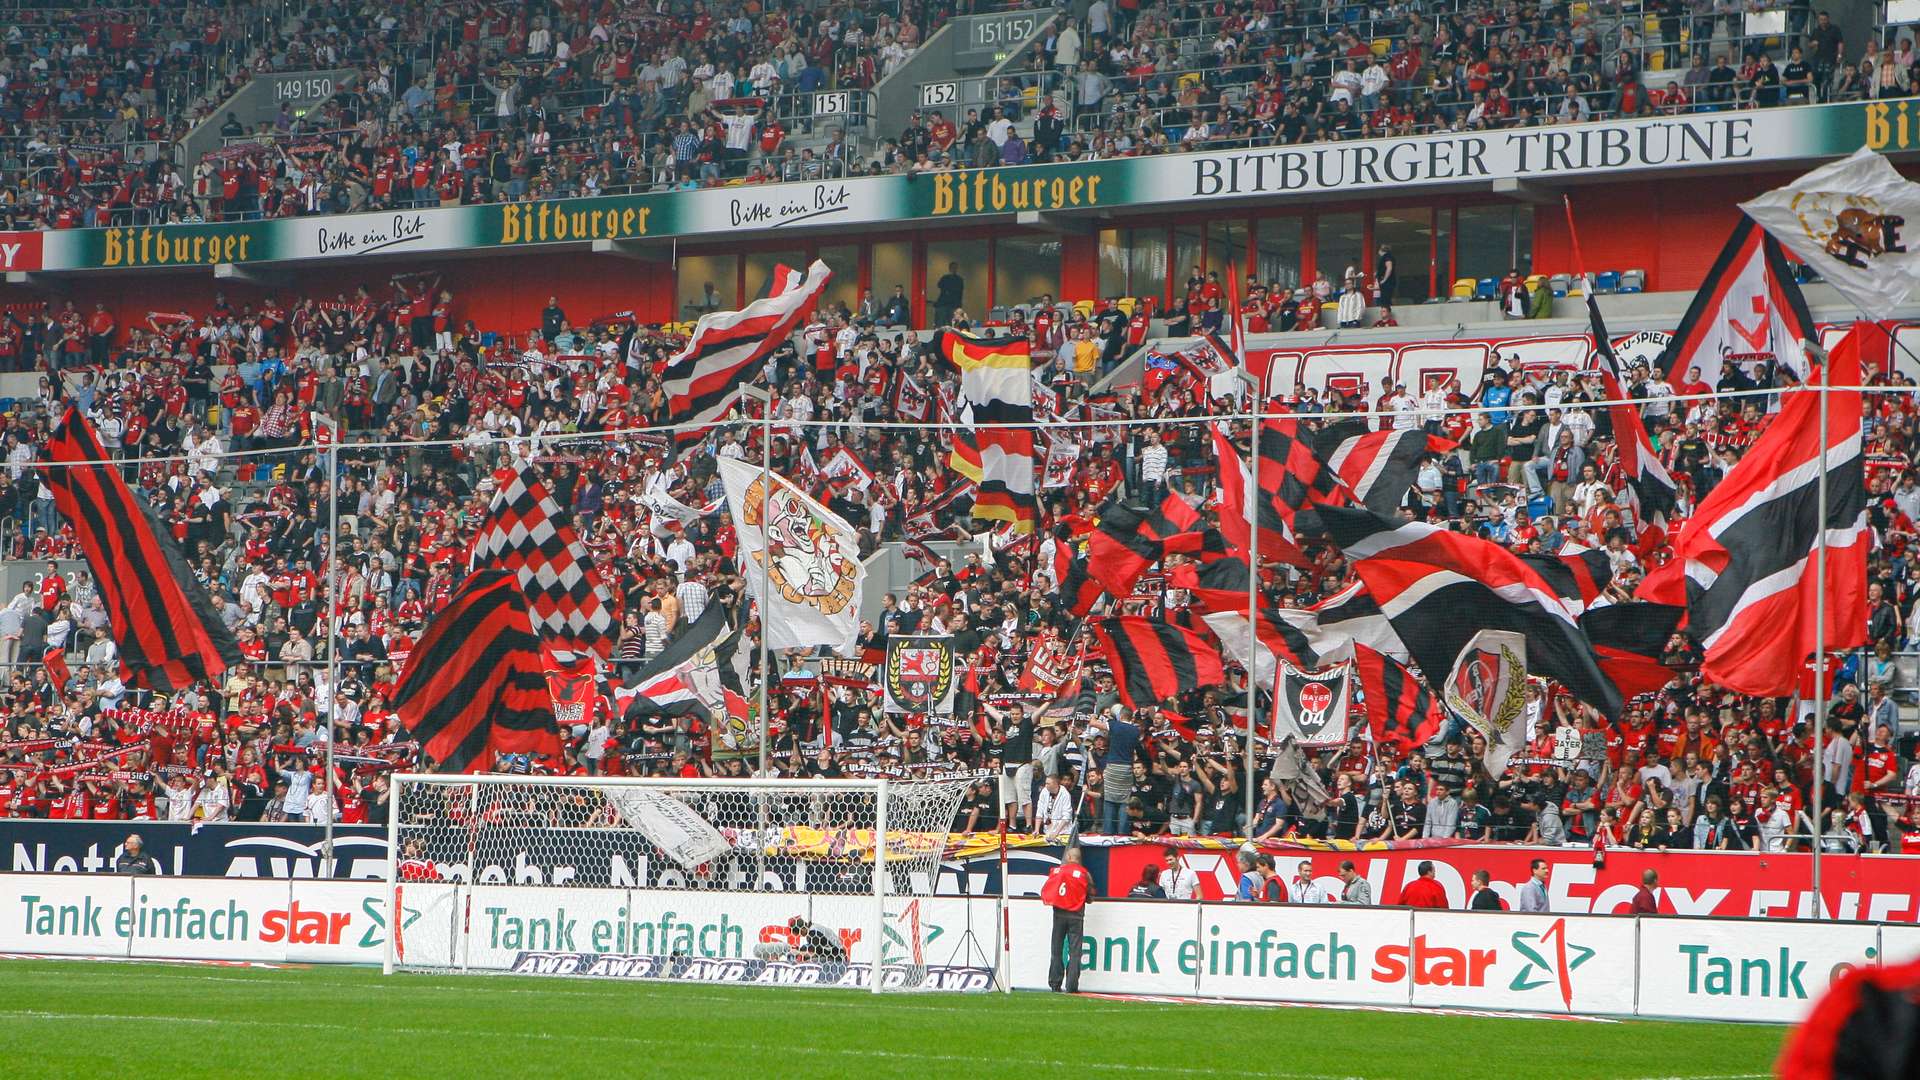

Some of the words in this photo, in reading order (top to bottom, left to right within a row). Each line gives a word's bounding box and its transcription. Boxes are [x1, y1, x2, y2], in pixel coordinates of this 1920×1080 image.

[978, 23, 1001, 44] 151
[1005, 19, 1033, 40] 152
[276, 80, 302, 99] 149
[305, 78, 331, 97] 150
[818, 94, 846, 113] 151
[925, 84, 955, 104] 152
[1866, 102, 1920, 150] Bi
[1192, 137, 1492, 196] BITBURGER
[1505, 118, 1754, 173] TRIBÜNE
[730, 199, 772, 227] Bitte
[780, 204, 808, 217] ein
[814, 184, 851, 209] Bit
[931, 170, 1102, 215] Bitburger
[318, 228, 356, 254] Bitte
[362, 232, 387, 245] ein
[393, 214, 426, 239] Bit
[500, 201, 650, 244] Bitburger
[0, 242, 22, 268] Y
[102, 227, 251, 267] Bitburger
[1299, 708, 1325, 727] 04
[131, 772, 150, 781] SIEG
[1058, 882, 1067, 897] 6
[20, 895, 103, 937] Tank
[114, 894, 248, 942] einfach
[258, 899, 351, 945] star
[484, 906, 577, 952] Tank
[592, 906, 744, 959] einfach
[515, 958, 579, 975] AWD
[587, 959, 652, 977] AWD
[680, 962, 745, 981] AWD
[755, 964, 820, 985] AWD
[837, 970, 906, 987] AWD
[920, 971, 989, 992] AWD
[1063, 926, 1161, 975] ank
[1176, 925, 1357, 981] einfach
[1370, 934, 1497, 988] star
[1678, 943, 1809, 1000] Tank
